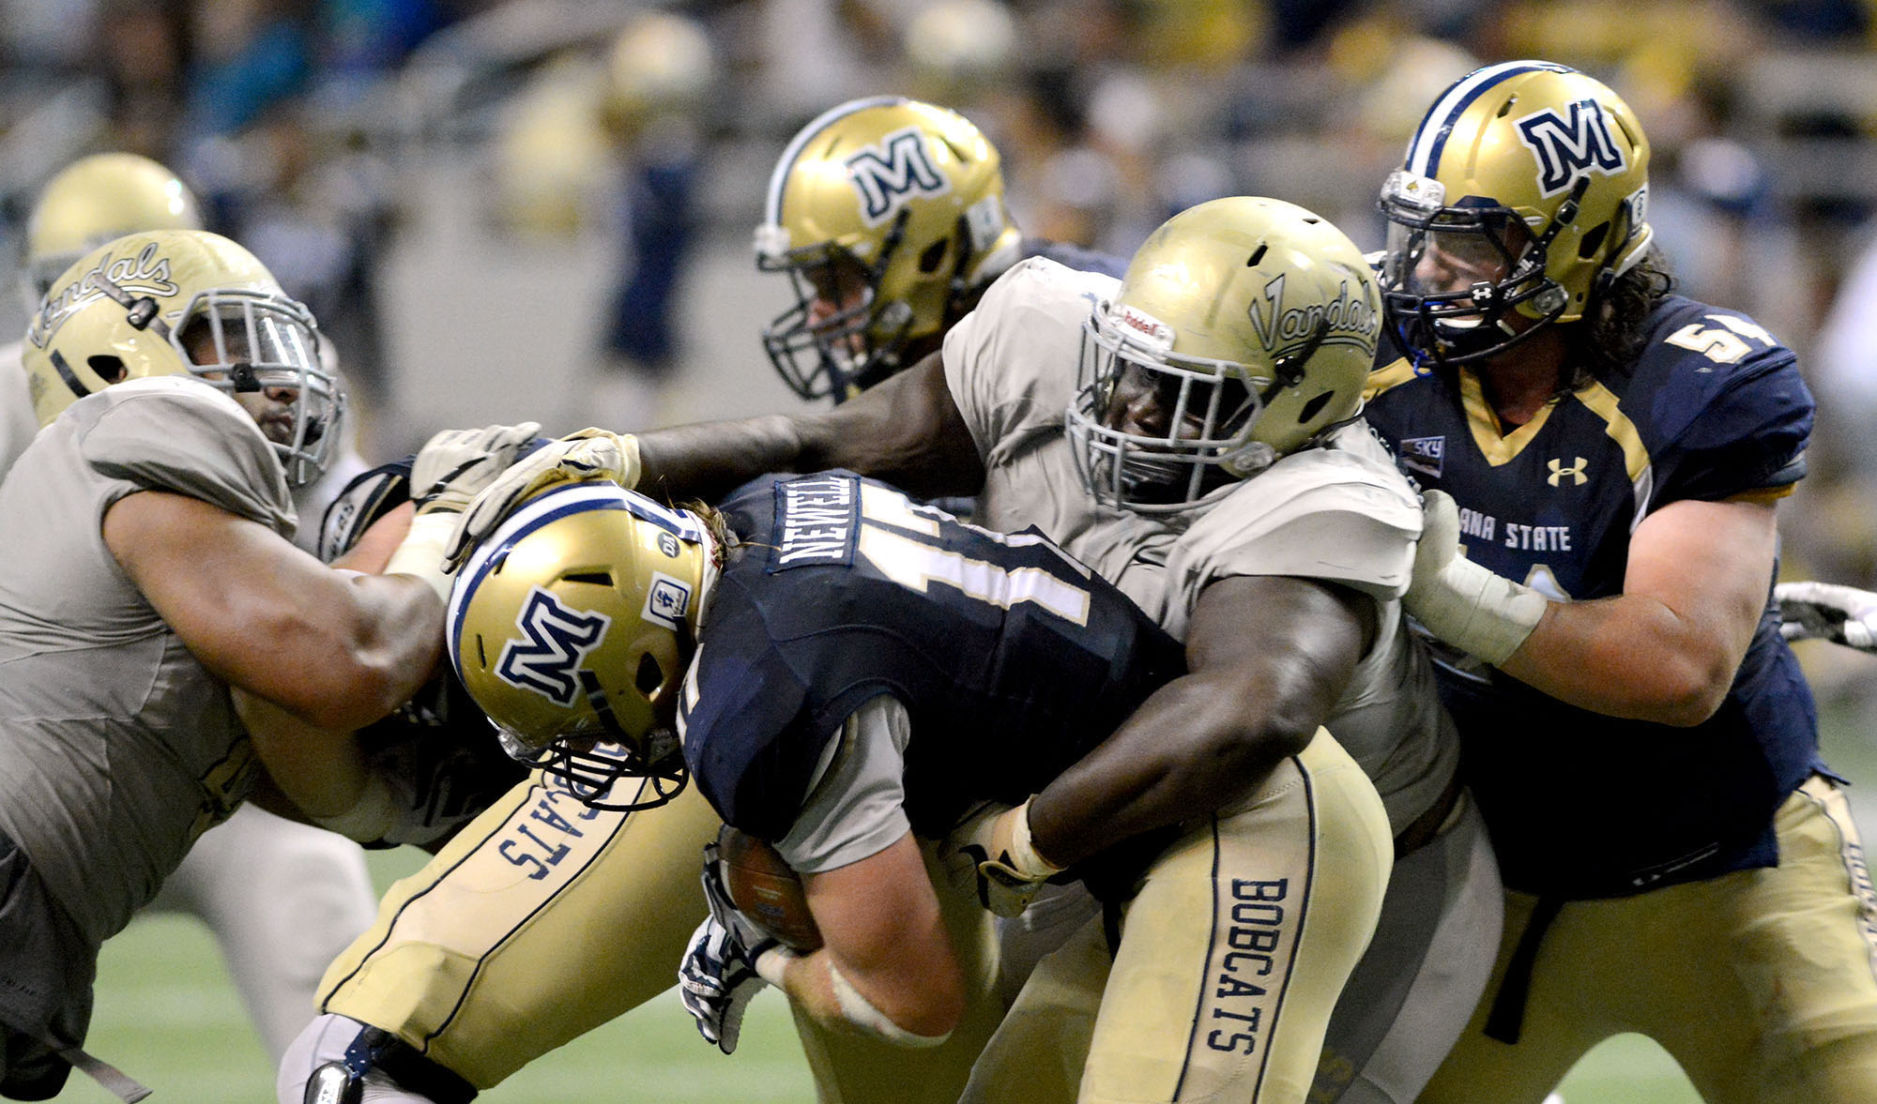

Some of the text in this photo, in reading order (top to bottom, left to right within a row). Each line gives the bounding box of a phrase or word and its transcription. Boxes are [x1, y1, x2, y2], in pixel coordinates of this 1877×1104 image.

[847, 127, 949, 227] M
[1516, 98, 1626, 197] M
[1414, 440, 1442, 458] SKY
[779, 476, 850, 565] NEWELL
[1505, 522, 1572, 552] STATE
[494, 585, 611, 706] M
[1207, 878, 1288, 1056] BOBCATS
